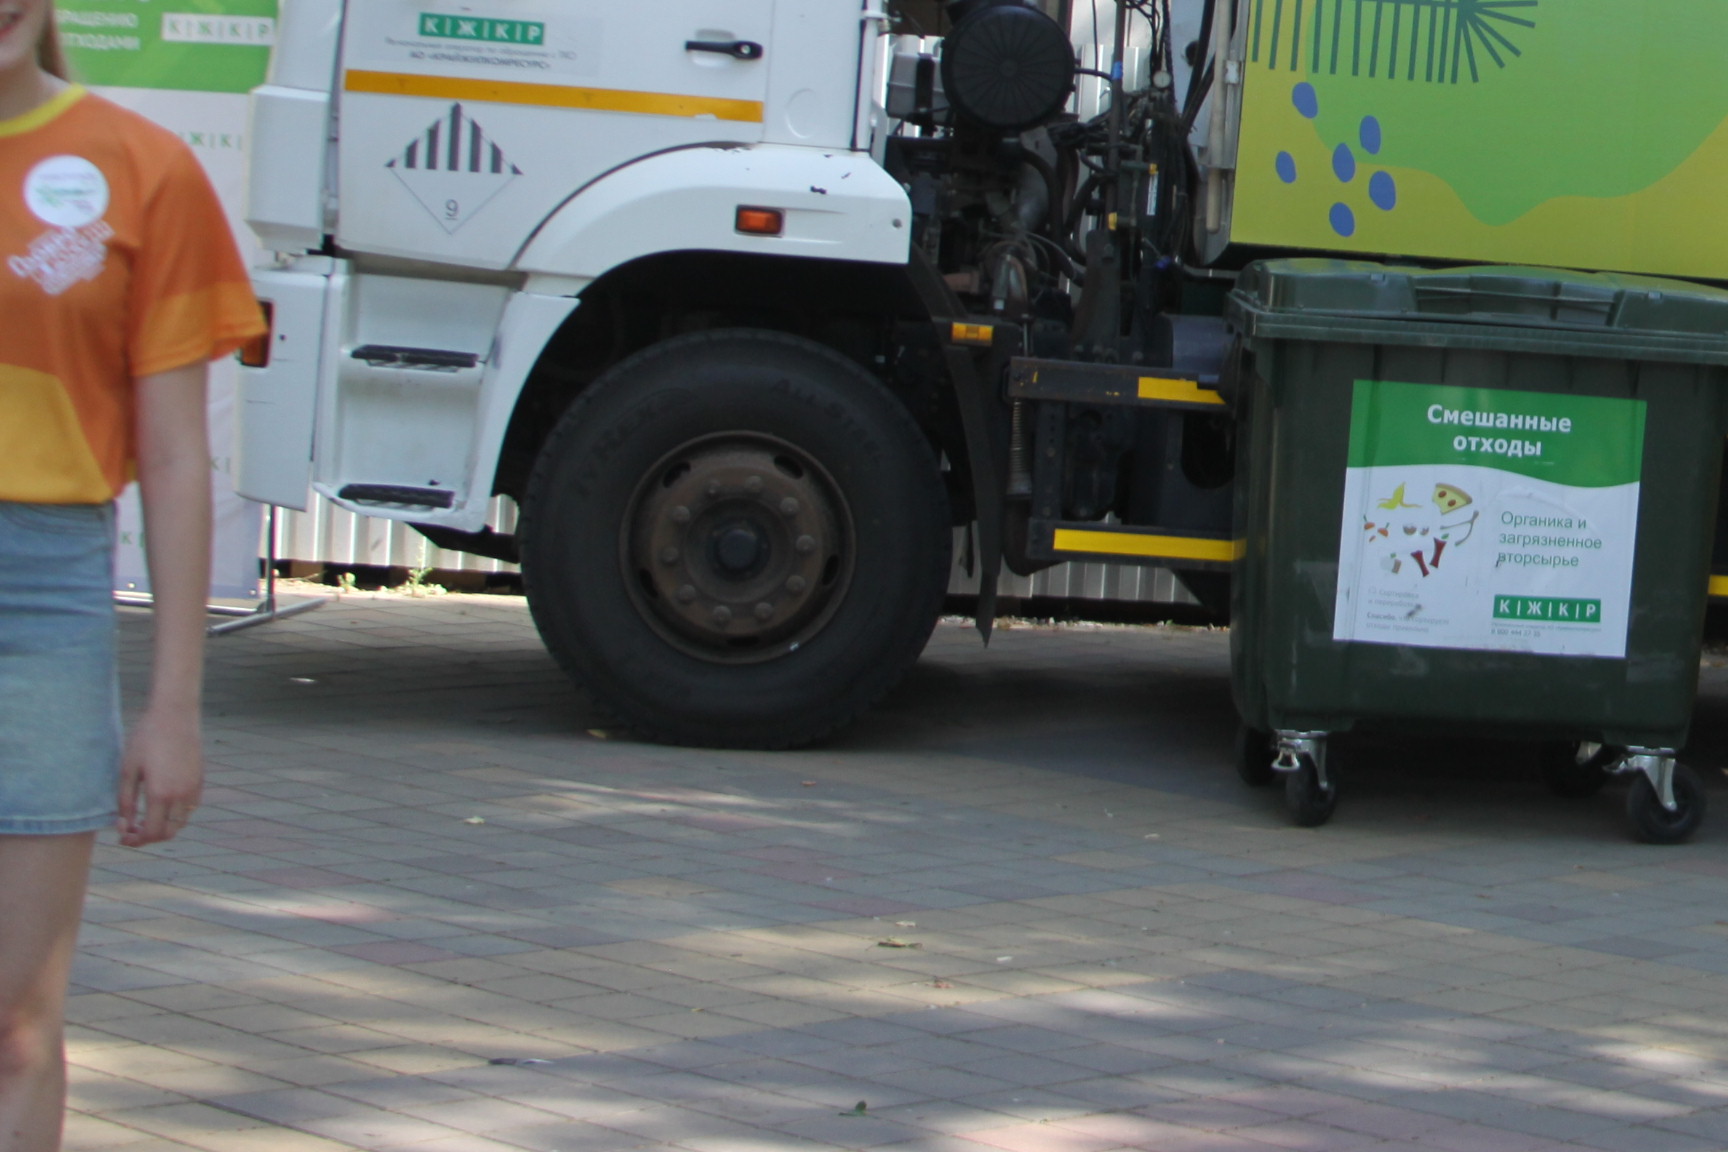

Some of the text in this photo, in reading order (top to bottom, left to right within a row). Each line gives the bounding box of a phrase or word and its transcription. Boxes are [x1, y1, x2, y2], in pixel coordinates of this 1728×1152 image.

[1426, 403, 1573, 433] Смешанные
[1452, 434, 1543, 457] отходы
[1500, 510, 1588, 529] Органика и
[1499, 532, 1603, 549] загрязненное
[1497, 552, 1580, 567] вторсырье
